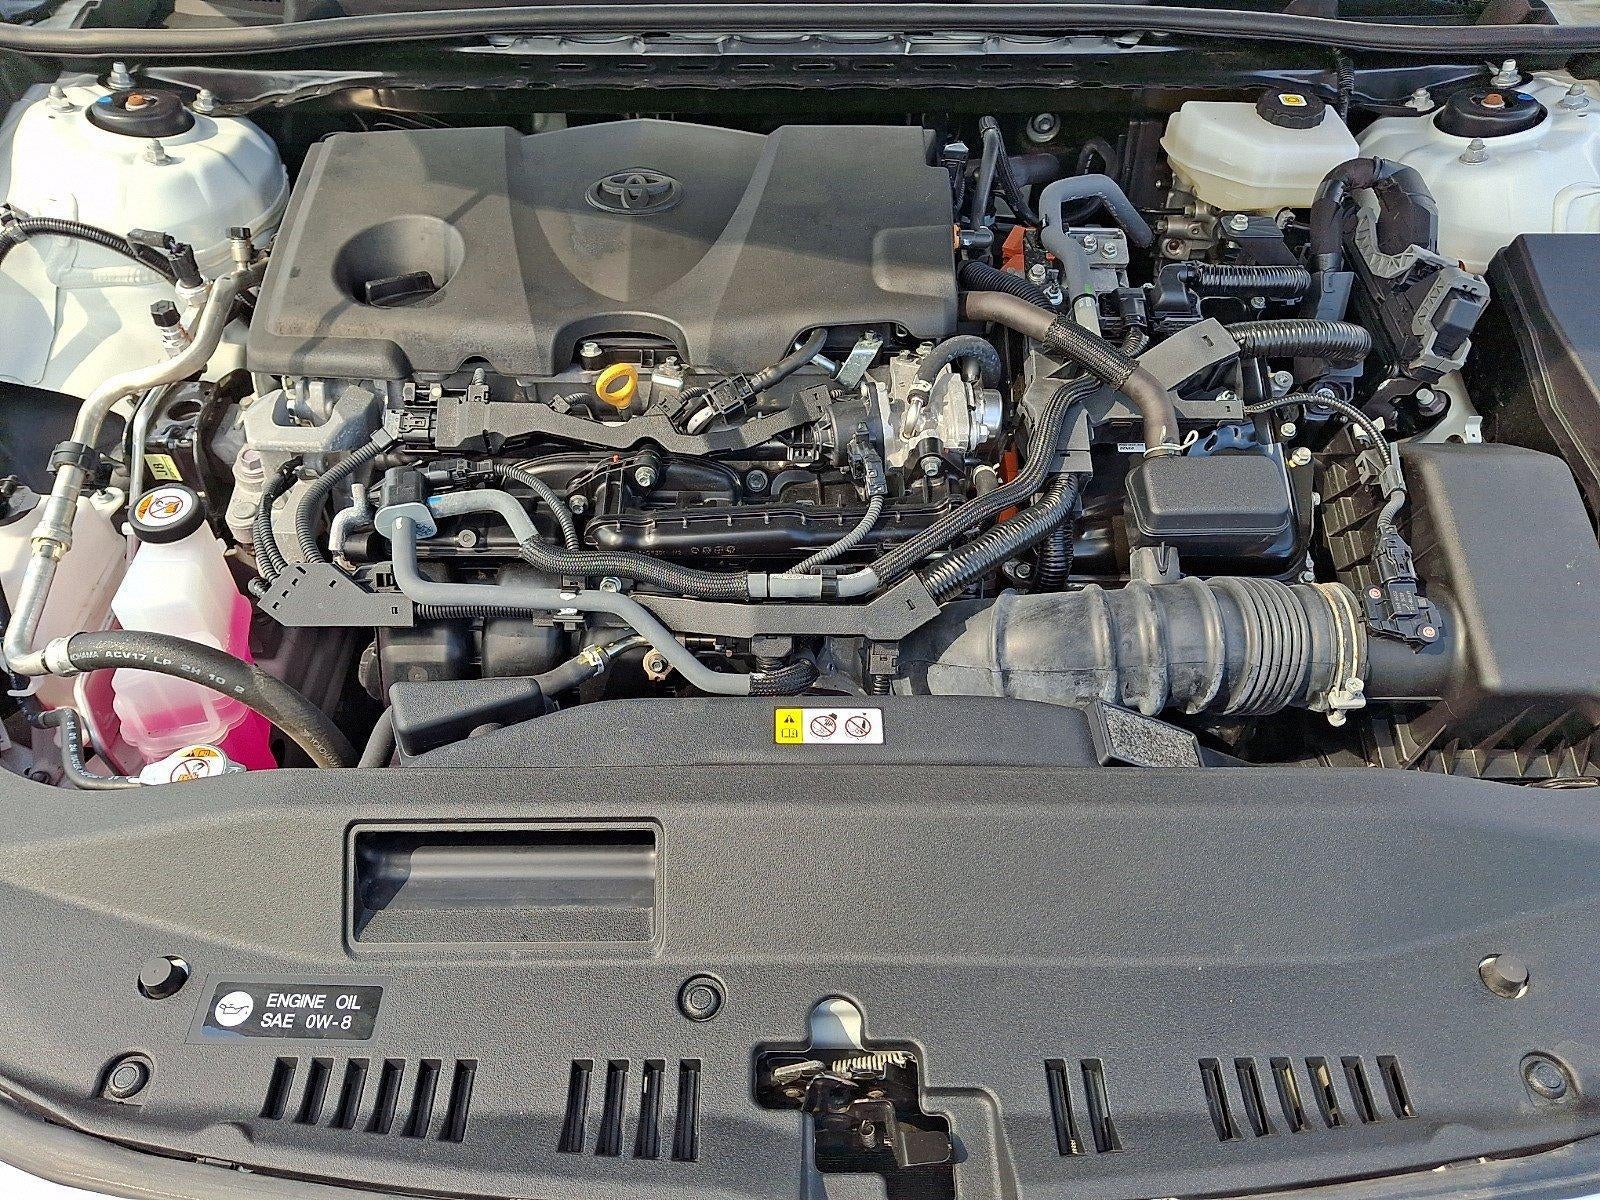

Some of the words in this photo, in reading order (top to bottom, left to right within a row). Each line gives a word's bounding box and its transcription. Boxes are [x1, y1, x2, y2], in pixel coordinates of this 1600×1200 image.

[105, 651, 147, 661] ACV17
[153, 656, 172, 666] LP
[266, 993, 326, 1009] ENGINE
[335, 994, 361, 1010] OIL
[260, 1012, 296, 1028] SAE
[305, 1014, 353, 1030] 0W-8
